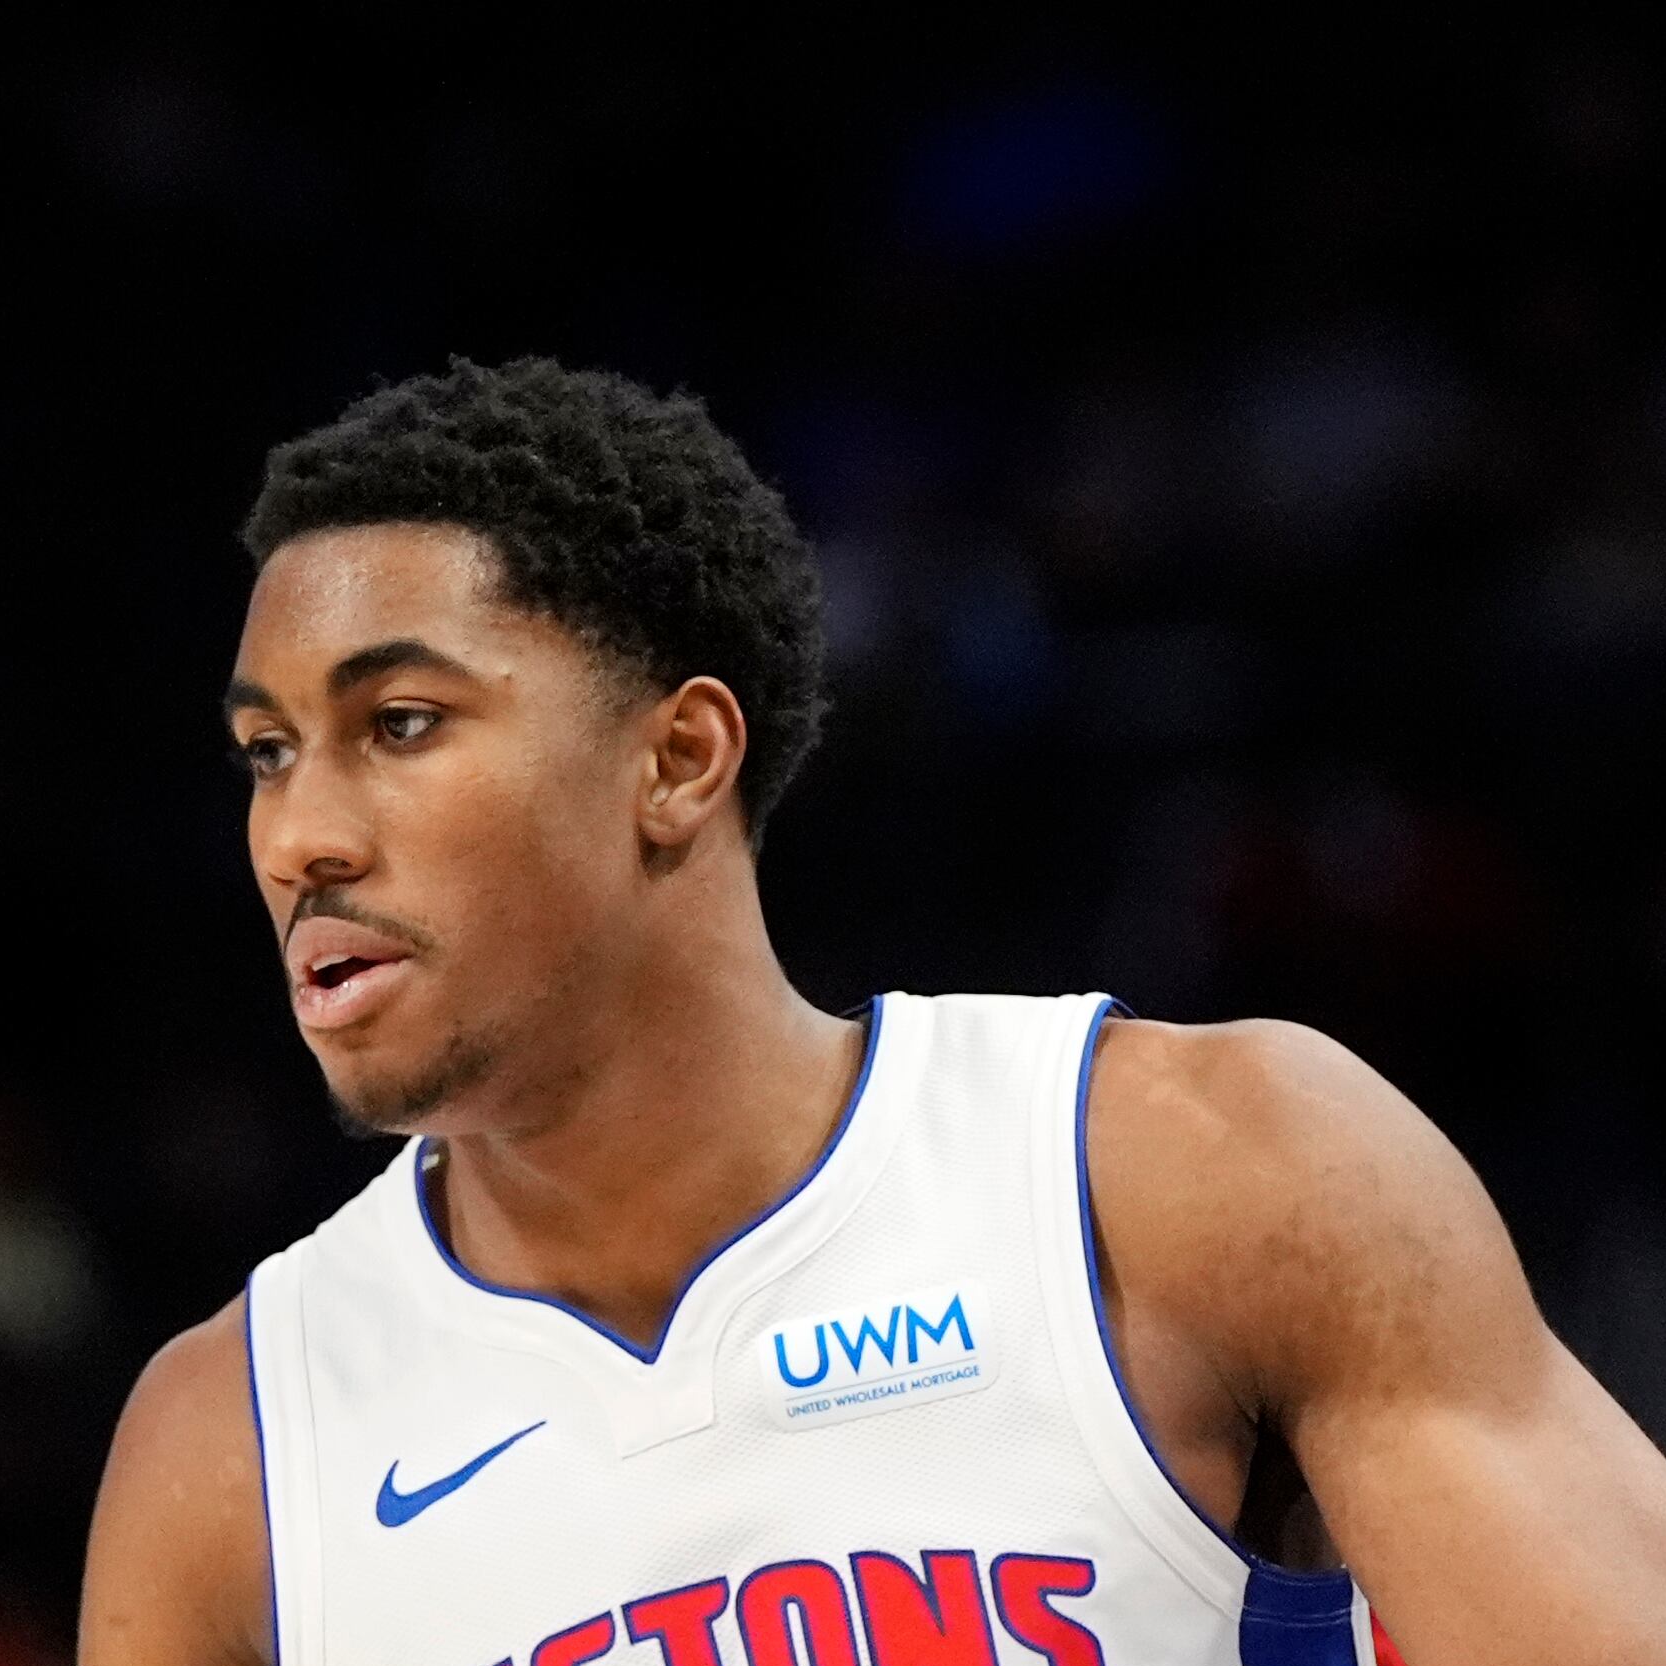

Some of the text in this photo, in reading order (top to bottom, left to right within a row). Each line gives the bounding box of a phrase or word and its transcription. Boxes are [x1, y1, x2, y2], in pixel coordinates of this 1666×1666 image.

[773, 1293, 975, 1389] UWM
[786, 1365, 981, 1418] UNITED WHOLESALE MORTGAGE
